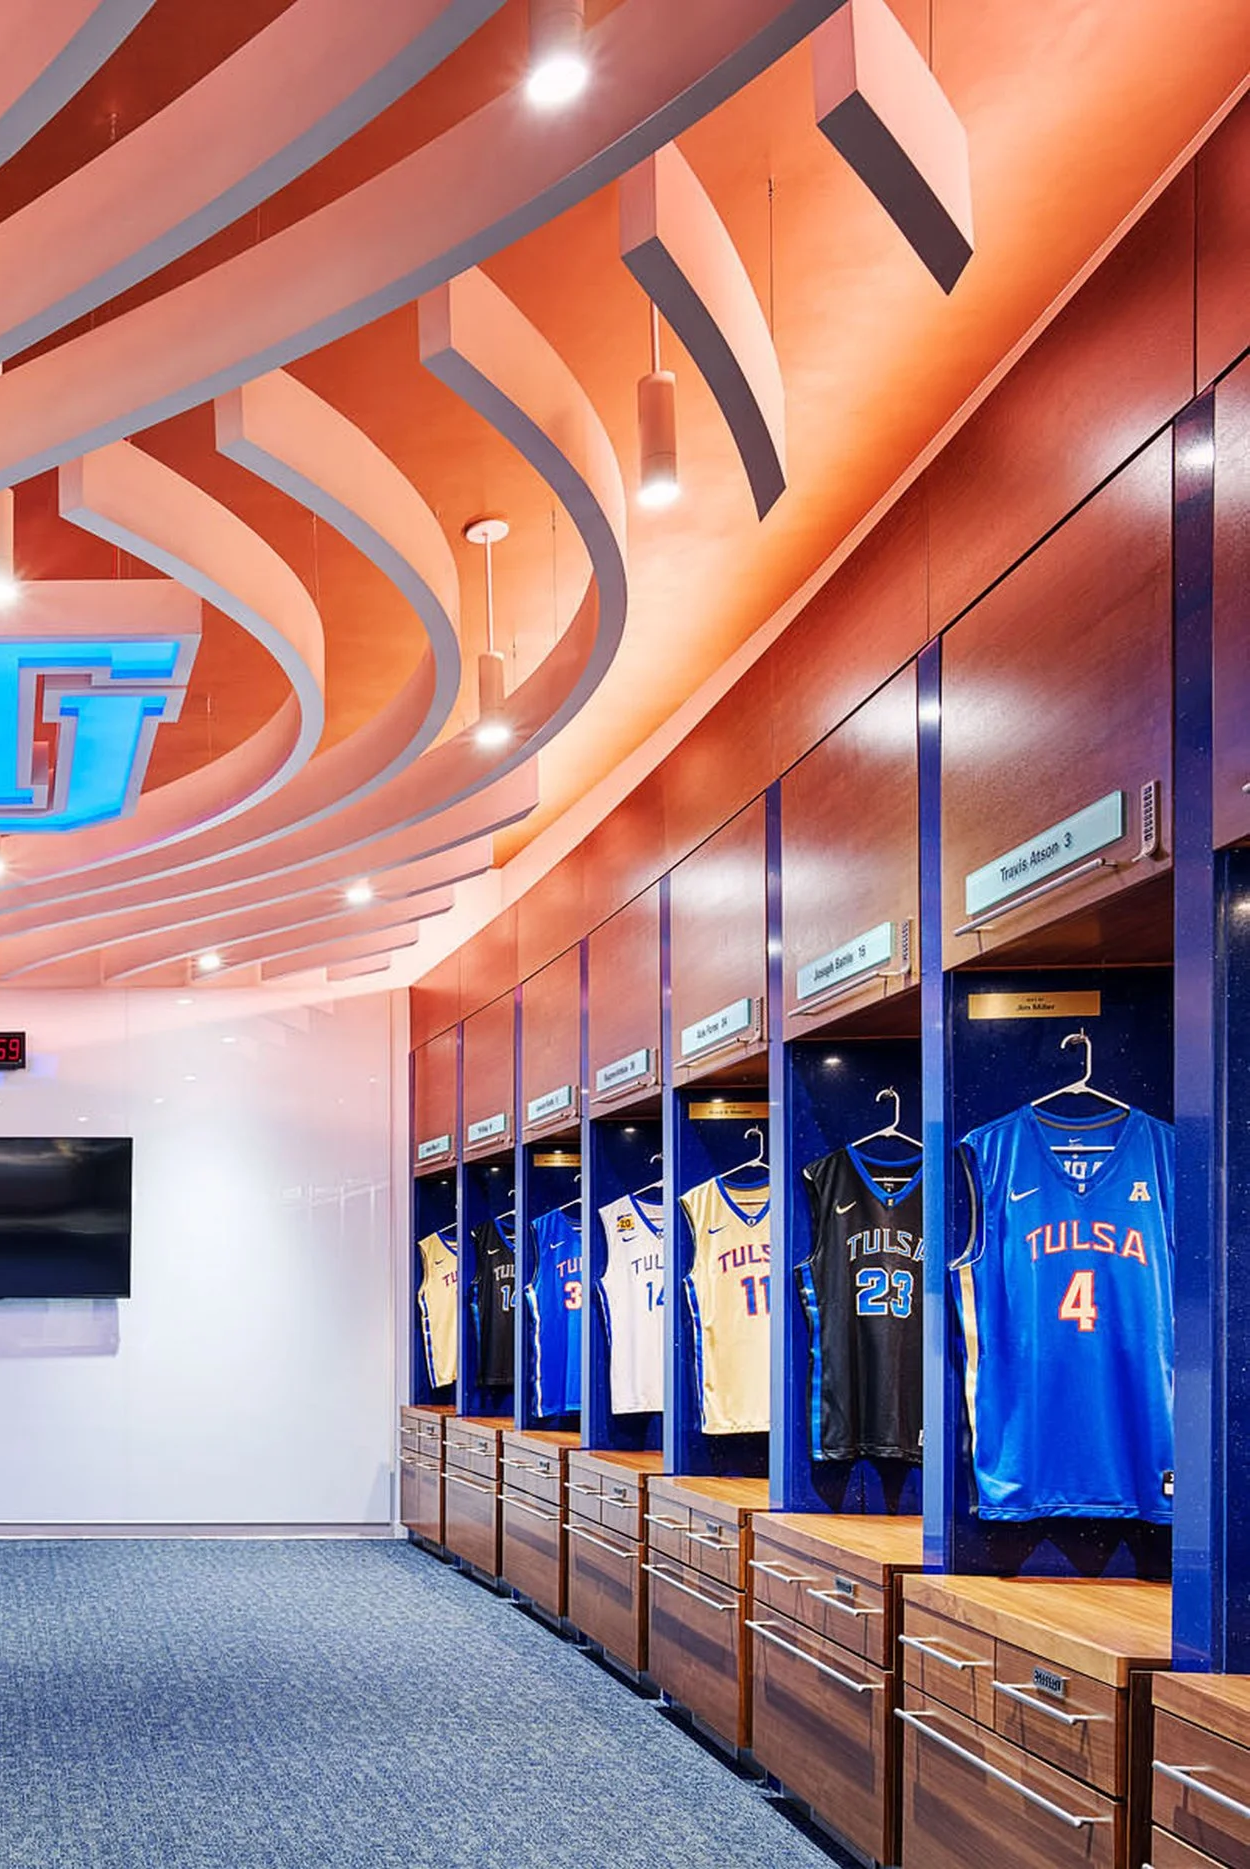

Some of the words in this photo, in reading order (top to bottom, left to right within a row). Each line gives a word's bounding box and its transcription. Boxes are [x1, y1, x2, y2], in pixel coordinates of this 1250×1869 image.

[1000, 858, 1027, 883] Travis
[1029, 842, 1060, 867] Atson
[1063, 832, 1073, 849] 3
[631, 1253, 664, 1275] TUL
[718, 1244, 770, 1274] TULS
[1025, 1220, 1148, 1267] TULSA
[855, 1267, 914, 1319] 23
[1058, 1269, 1098, 1333] 4
